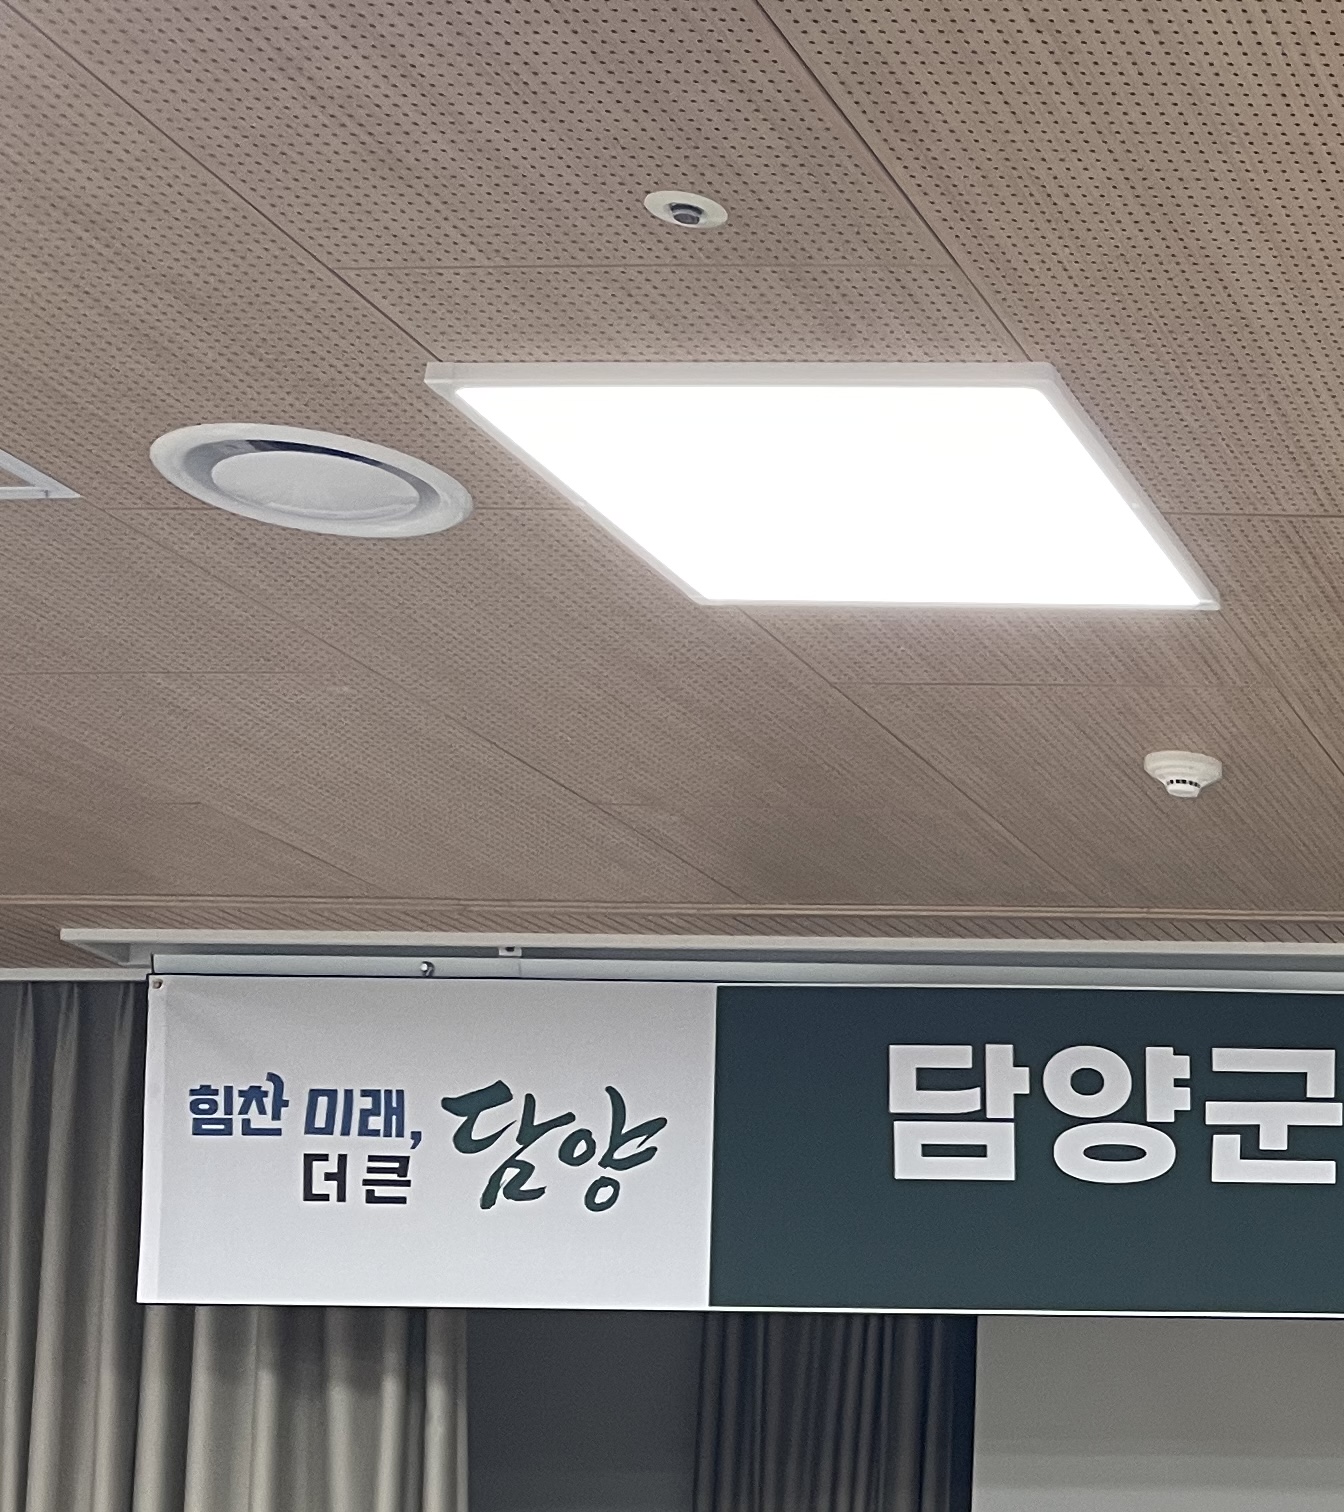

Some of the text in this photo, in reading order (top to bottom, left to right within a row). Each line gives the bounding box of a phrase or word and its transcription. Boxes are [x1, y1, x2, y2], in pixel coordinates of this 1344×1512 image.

[188, 1071, 424, 1150] 힘찬 미래,
[440, 1079, 669, 1213] 담양
[887, 1042, 1344, 1186] 담양군
[302, 1152, 413, 1205] 더 큰
